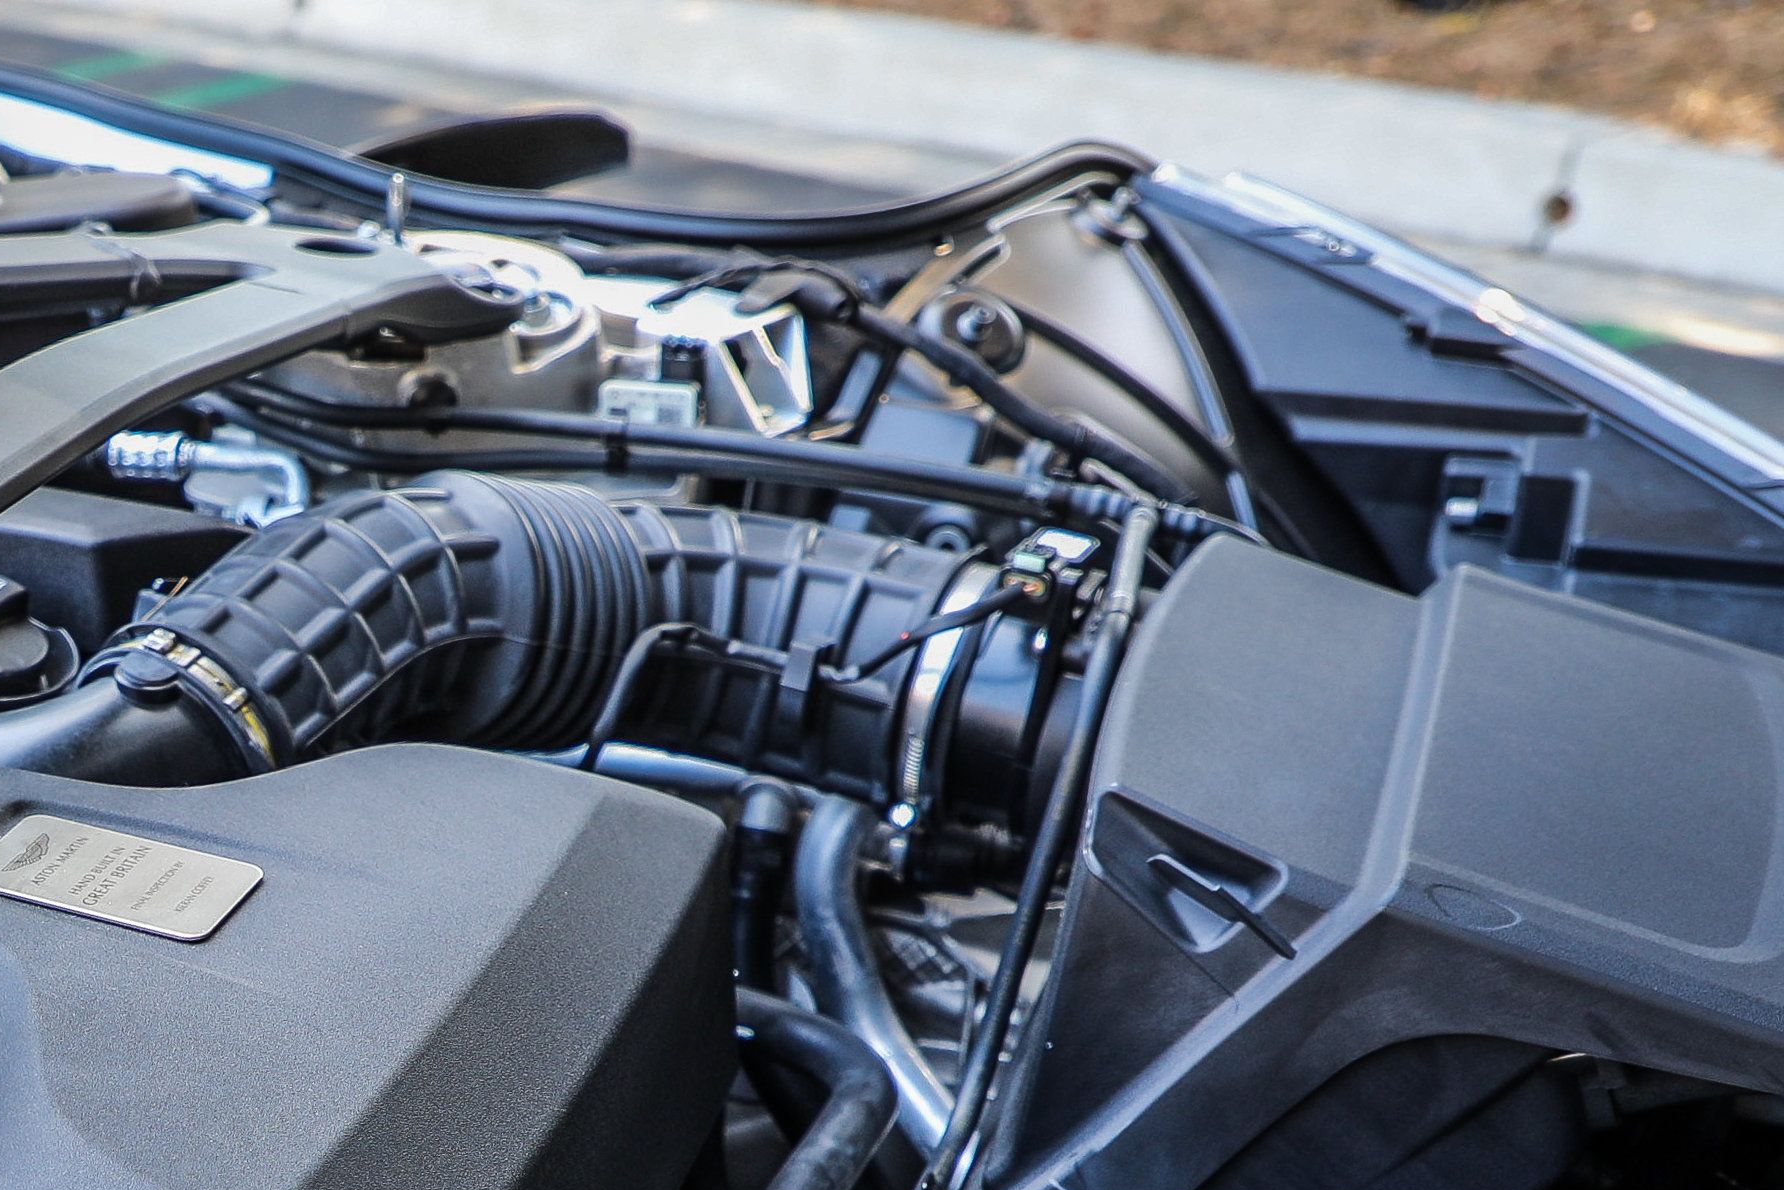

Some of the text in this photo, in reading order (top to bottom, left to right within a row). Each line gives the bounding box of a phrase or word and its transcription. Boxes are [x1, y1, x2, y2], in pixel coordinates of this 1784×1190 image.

[32, 837, 88, 886] ASTON MARTIN
[68, 846, 126, 895] HAND BUILT IN
[83, 845, 152, 905] GREAT BRITAIN
[130, 896, 152, 911] FINAL
[145, 865, 179, 896] INSPECTION
